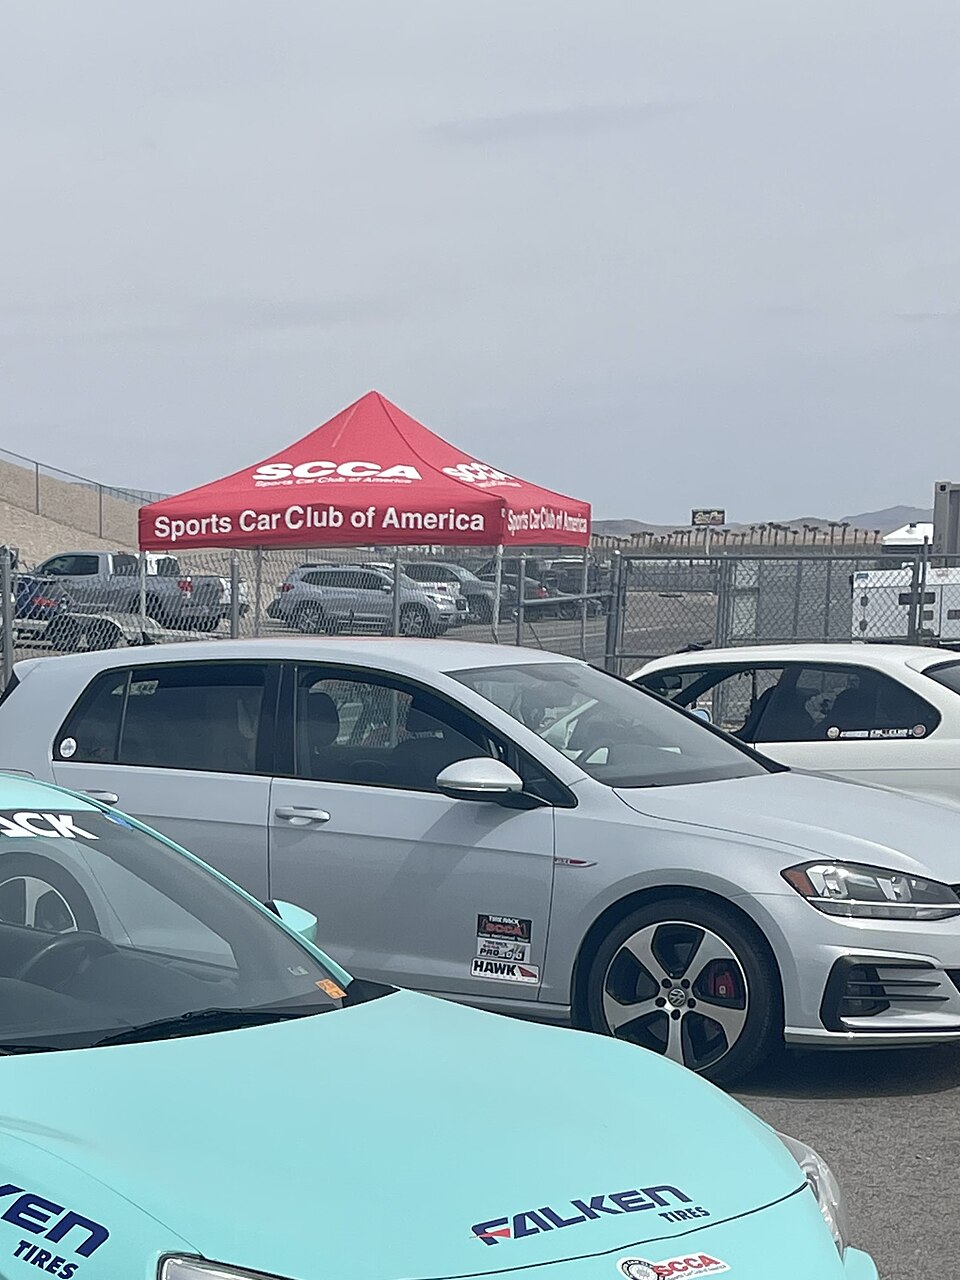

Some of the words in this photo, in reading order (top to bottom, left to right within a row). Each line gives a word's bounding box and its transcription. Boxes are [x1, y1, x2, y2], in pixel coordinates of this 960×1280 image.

[252, 461, 422, 481] SCCA
[154, 513, 233, 542] Sports
[239, 509, 281, 532] Car
[284, 505, 344, 530] Club
[350, 506, 376, 528] of
[382, 506, 485, 531] America
[507, 509, 529, 536] Sports
[529, 508, 541, 530] Car
[540, 506, 555, 530] Club
[563, 511, 588, 533] America
[473, 960, 516, 977] HAWK
[470, 1185, 694, 1246] FALKEN
[657, 1206, 711, 1223] TIRES
[12, 1240, 80, 1280] TIRES
[652, 1255, 721, 1278] SCCA
